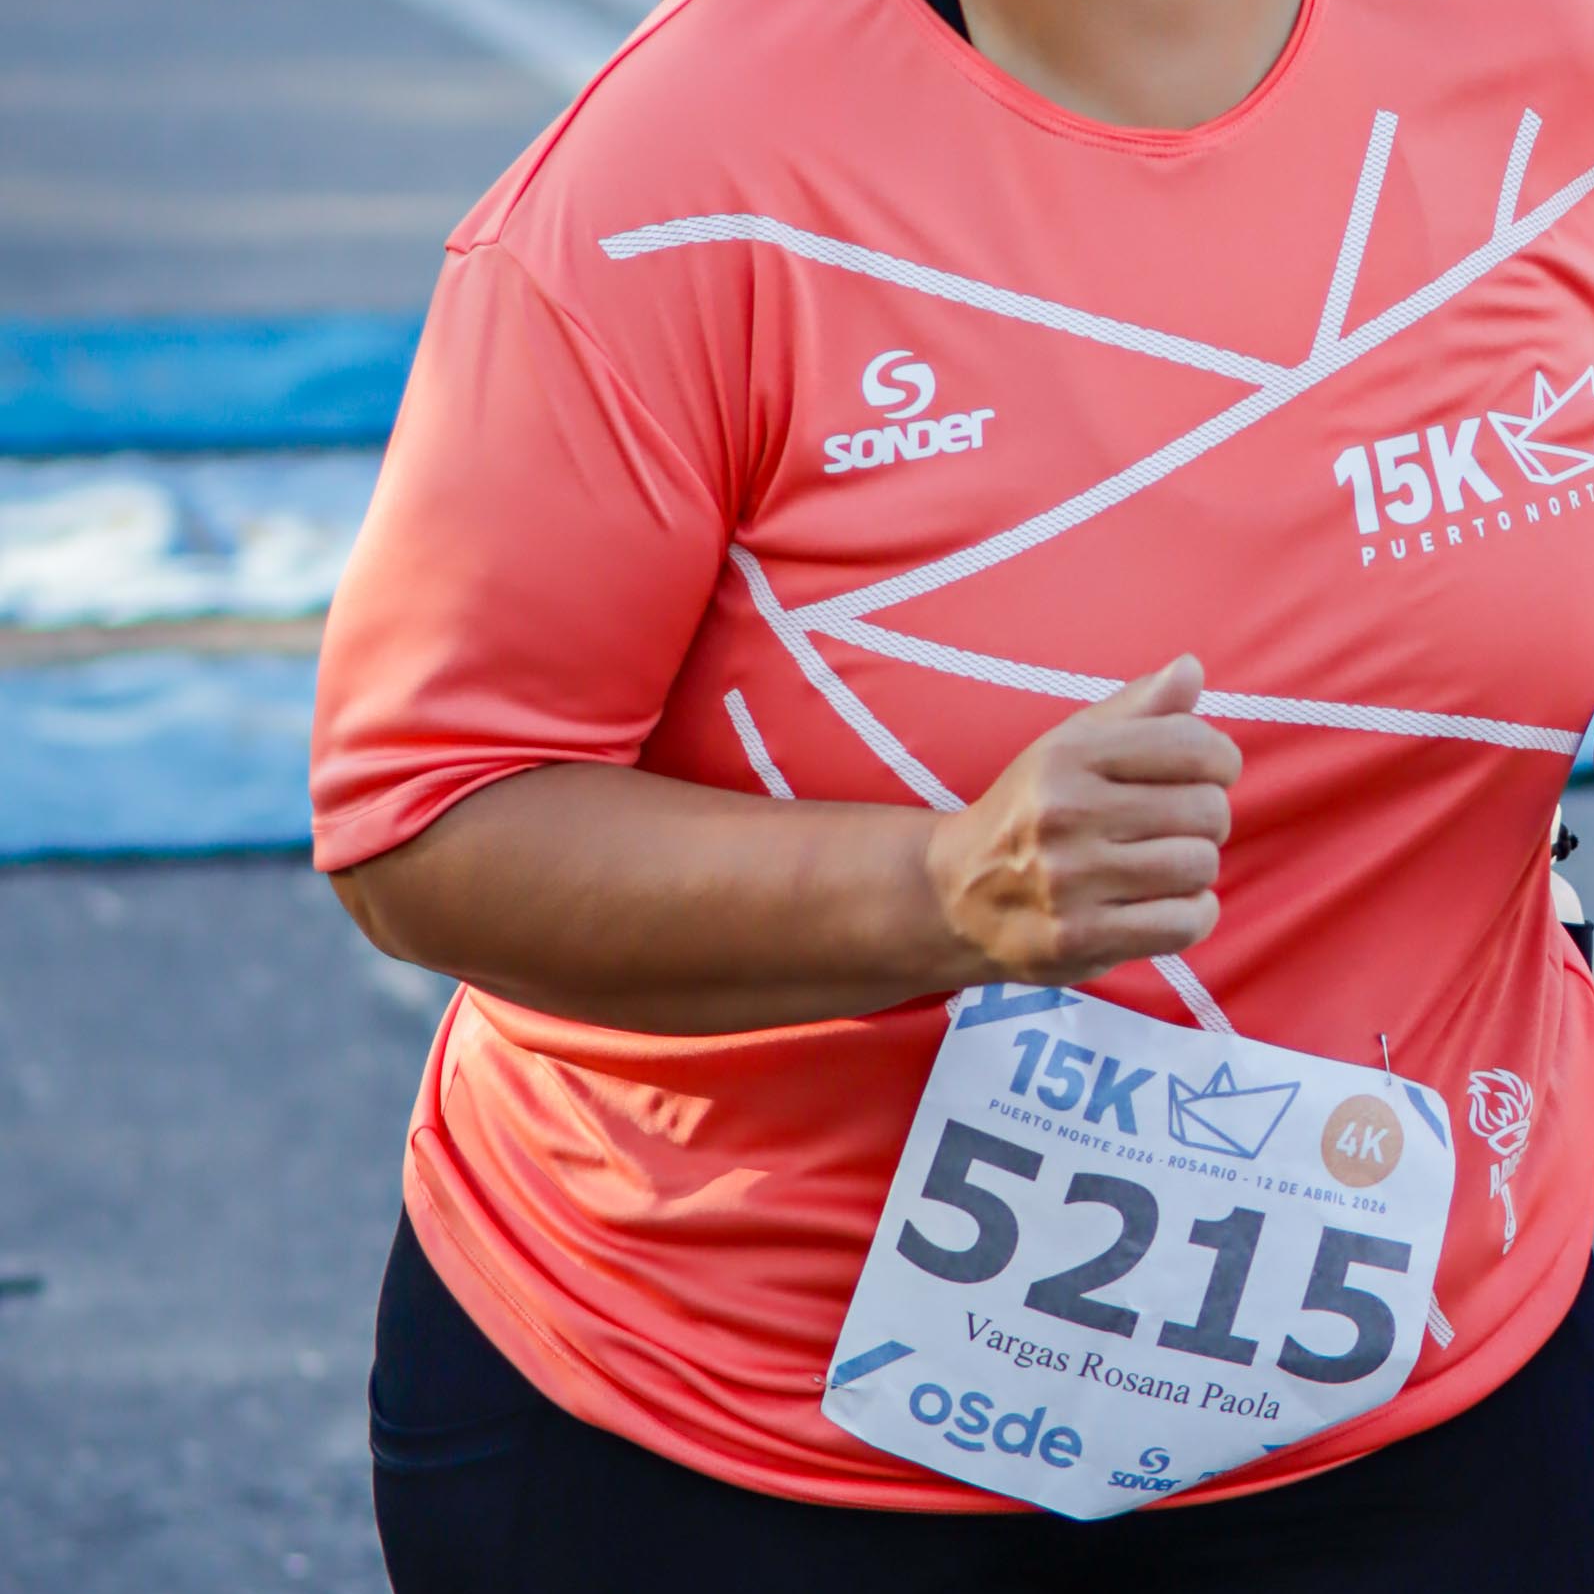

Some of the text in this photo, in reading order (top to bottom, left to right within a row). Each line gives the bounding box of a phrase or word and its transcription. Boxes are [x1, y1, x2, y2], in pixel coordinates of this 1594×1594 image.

[1333, 417, 1503, 535] 15K
[1361, 510, 1511, 567] PUERTO
[1009, 1028, 1157, 1136] 15K
[988, 1099, 1052, 1132] PUERTO
[1057, 1125, 1111, 1153] NORTE
[1116, 1144, 1154, 1164] 2026
[1167, 1158, 1237, 1182] ROSARIO
[1256, 1176, 1273, 1190] 12
[1278, 1181, 1298, 1196] DE
[1303, 1186, 1346, 1206] ABRIL
[1351, 1196, 1387, 1214] 2026
[1335, 1121, 1389, 1164] 4K
[895, 1118, 1412, 1385] 5215
[965, 1311, 1281, 1421] Vargas Rosana Paola
[909, 1382, 1083, 1469] osde
